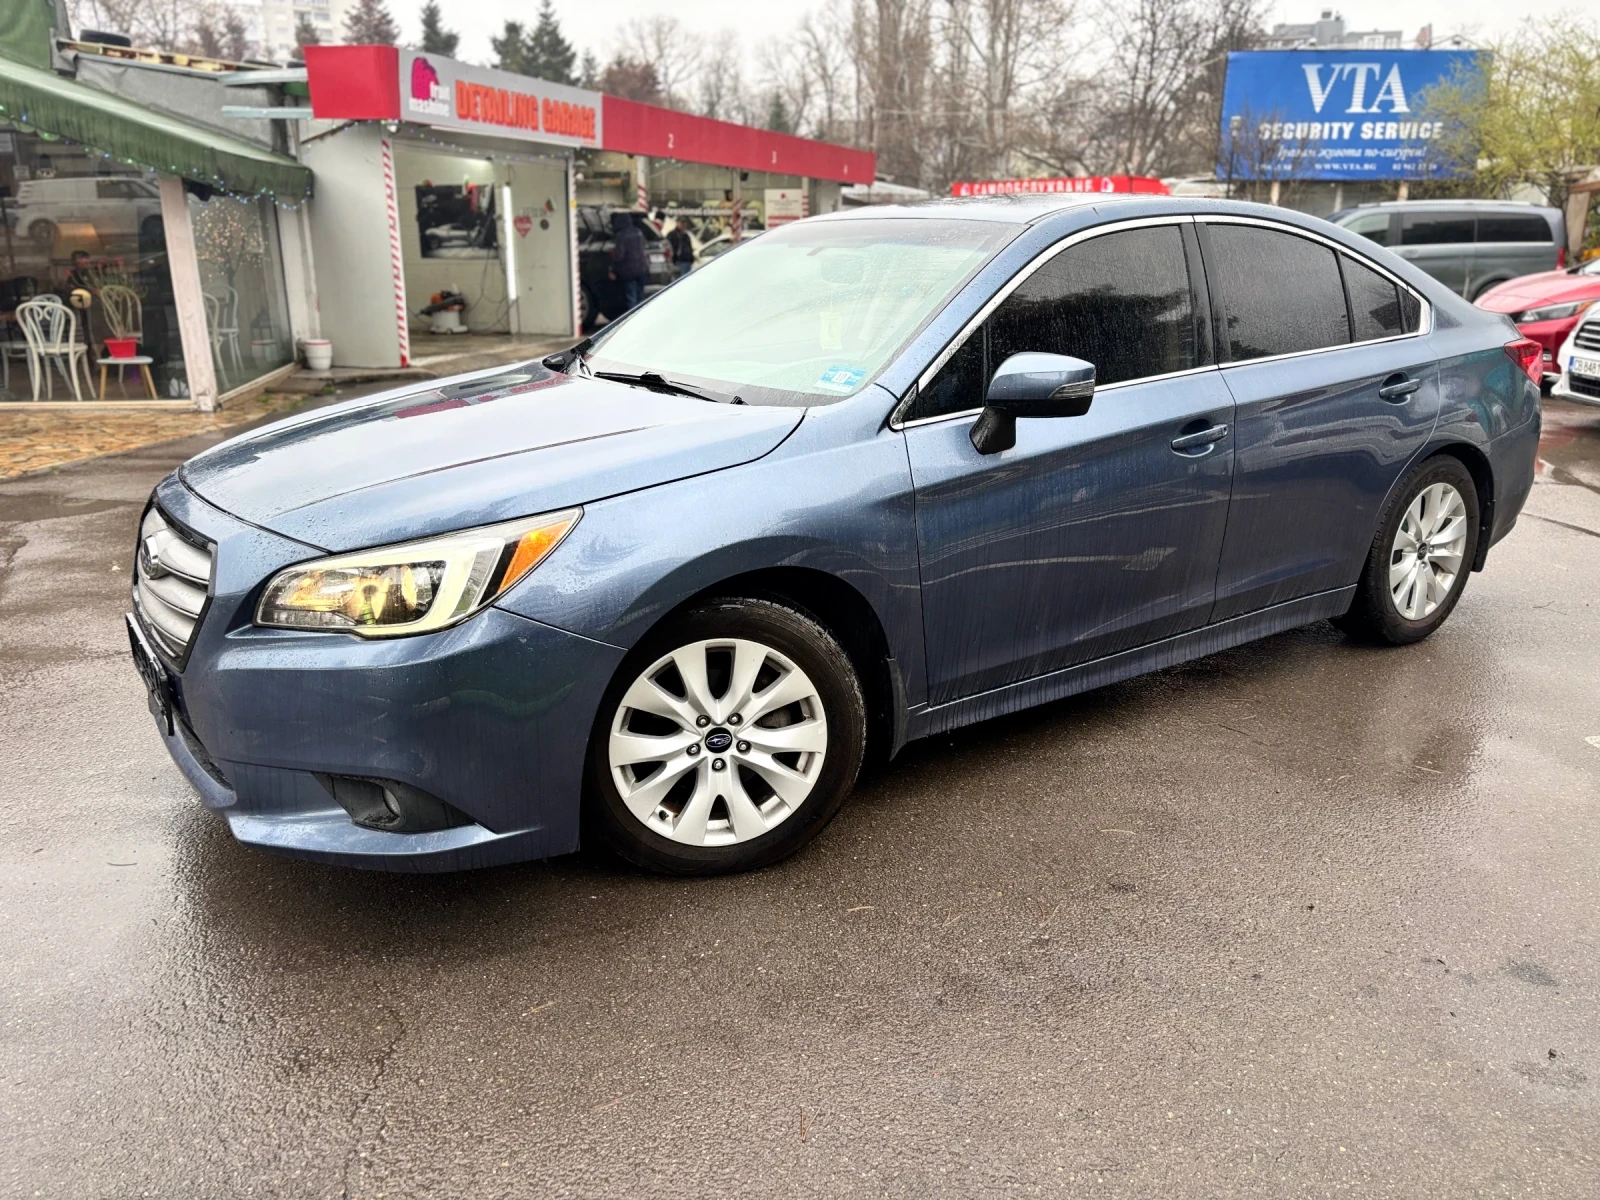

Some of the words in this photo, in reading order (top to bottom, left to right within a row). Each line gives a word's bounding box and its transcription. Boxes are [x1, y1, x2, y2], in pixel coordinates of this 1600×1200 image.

[1302, 63, 1411, 113] VTA
[455, 80, 539, 130] DETAILING
[542, 98, 595, 139] GARAGE
[1259, 122, 1354, 140] SECURITY
[1361, 122, 1444, 140] SERVICE
[668, 133, 675, 148] 2
[771, 151, 777, 164] 3
